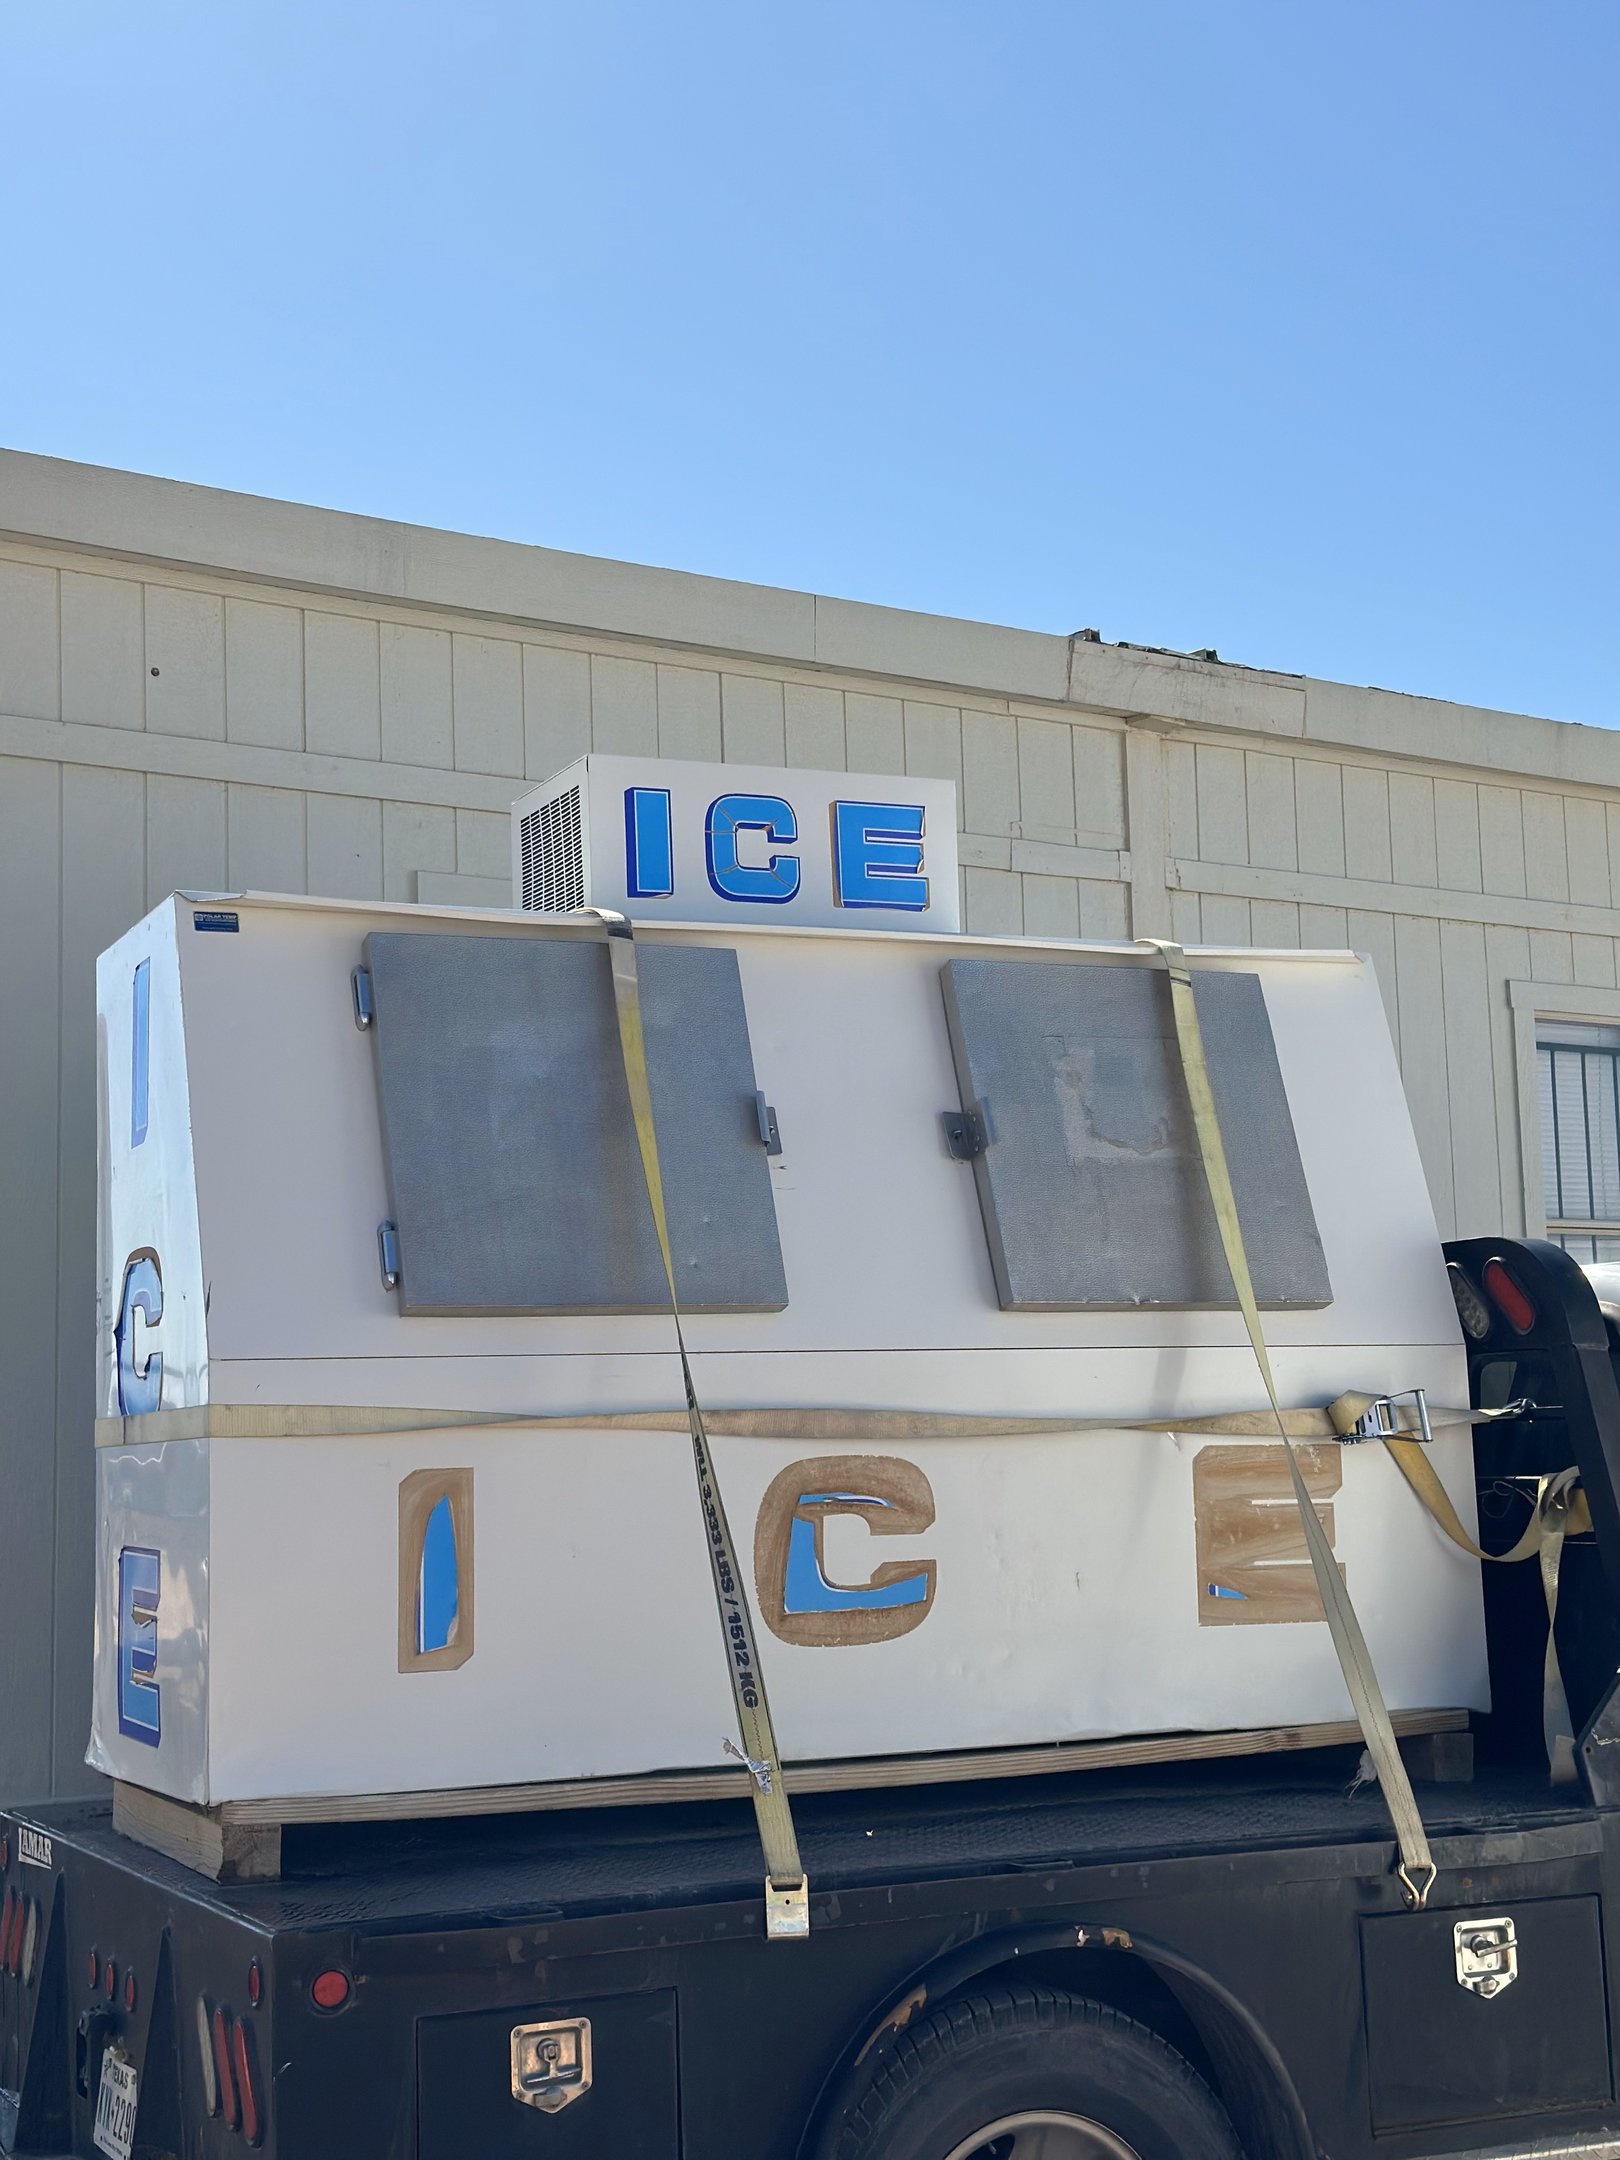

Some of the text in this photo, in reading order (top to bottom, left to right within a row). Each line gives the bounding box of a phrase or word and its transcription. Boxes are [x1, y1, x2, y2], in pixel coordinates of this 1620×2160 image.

[623, 786, 930, 912] ICE
[399, 1443, 1346, 1672] ICE
[715, 1550, 734, 1594] LBS
[728, 1611, 750, 1667] 1512
[739, 1671, 759, 1709] KG
[113, 2063, 129, 2090] TEXAS
